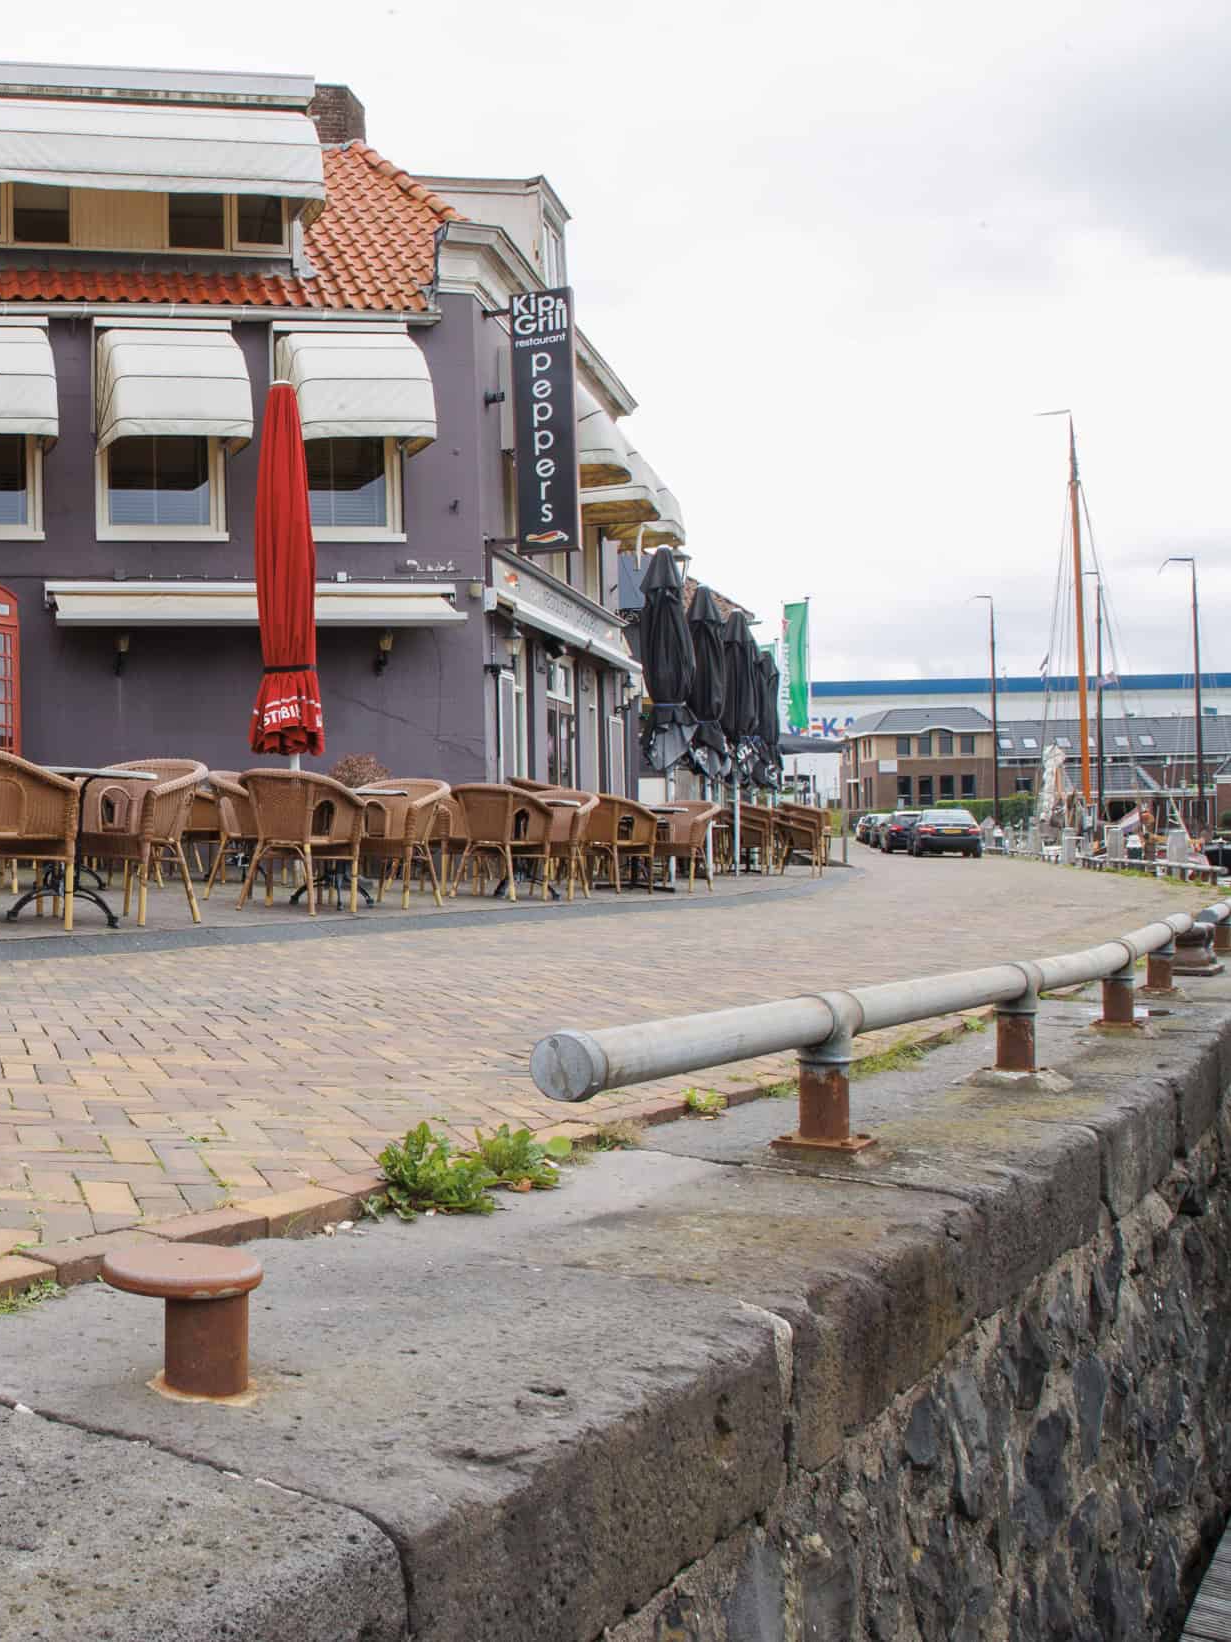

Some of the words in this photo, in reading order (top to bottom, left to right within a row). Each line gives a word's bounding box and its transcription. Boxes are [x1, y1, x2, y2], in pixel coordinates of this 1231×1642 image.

[514, 309, 568, 335] Grill
[515, 332, 566, 348] restaurant
[530, 351, 556, 522] peppers
